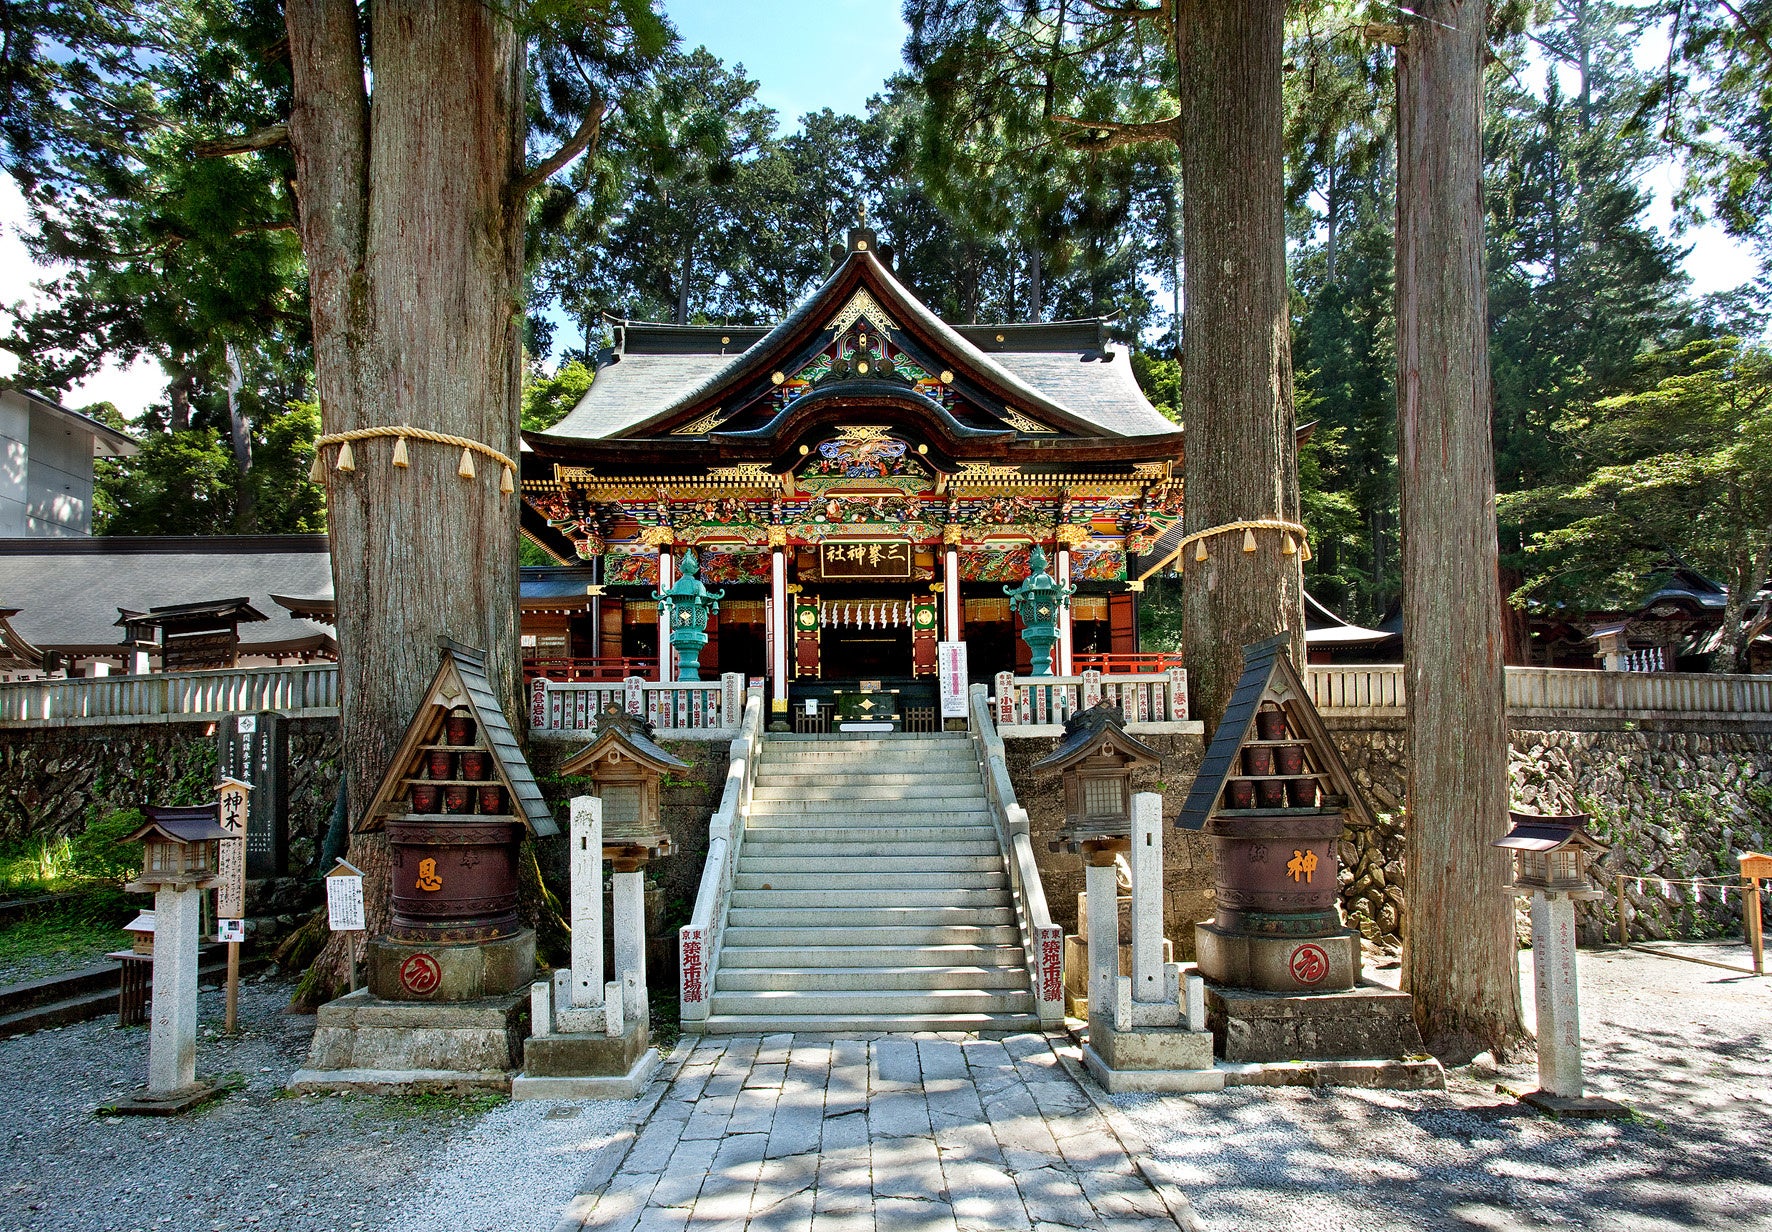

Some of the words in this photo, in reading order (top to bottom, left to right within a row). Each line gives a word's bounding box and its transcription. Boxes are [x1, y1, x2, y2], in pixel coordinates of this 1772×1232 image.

[223, 791, 243, 832] 神木
[1286, 849, 1319, 883] 神
[682, 940, 703, 1003] 築地市場講
[1042, 940, 1063, 1002] 築地市場講
